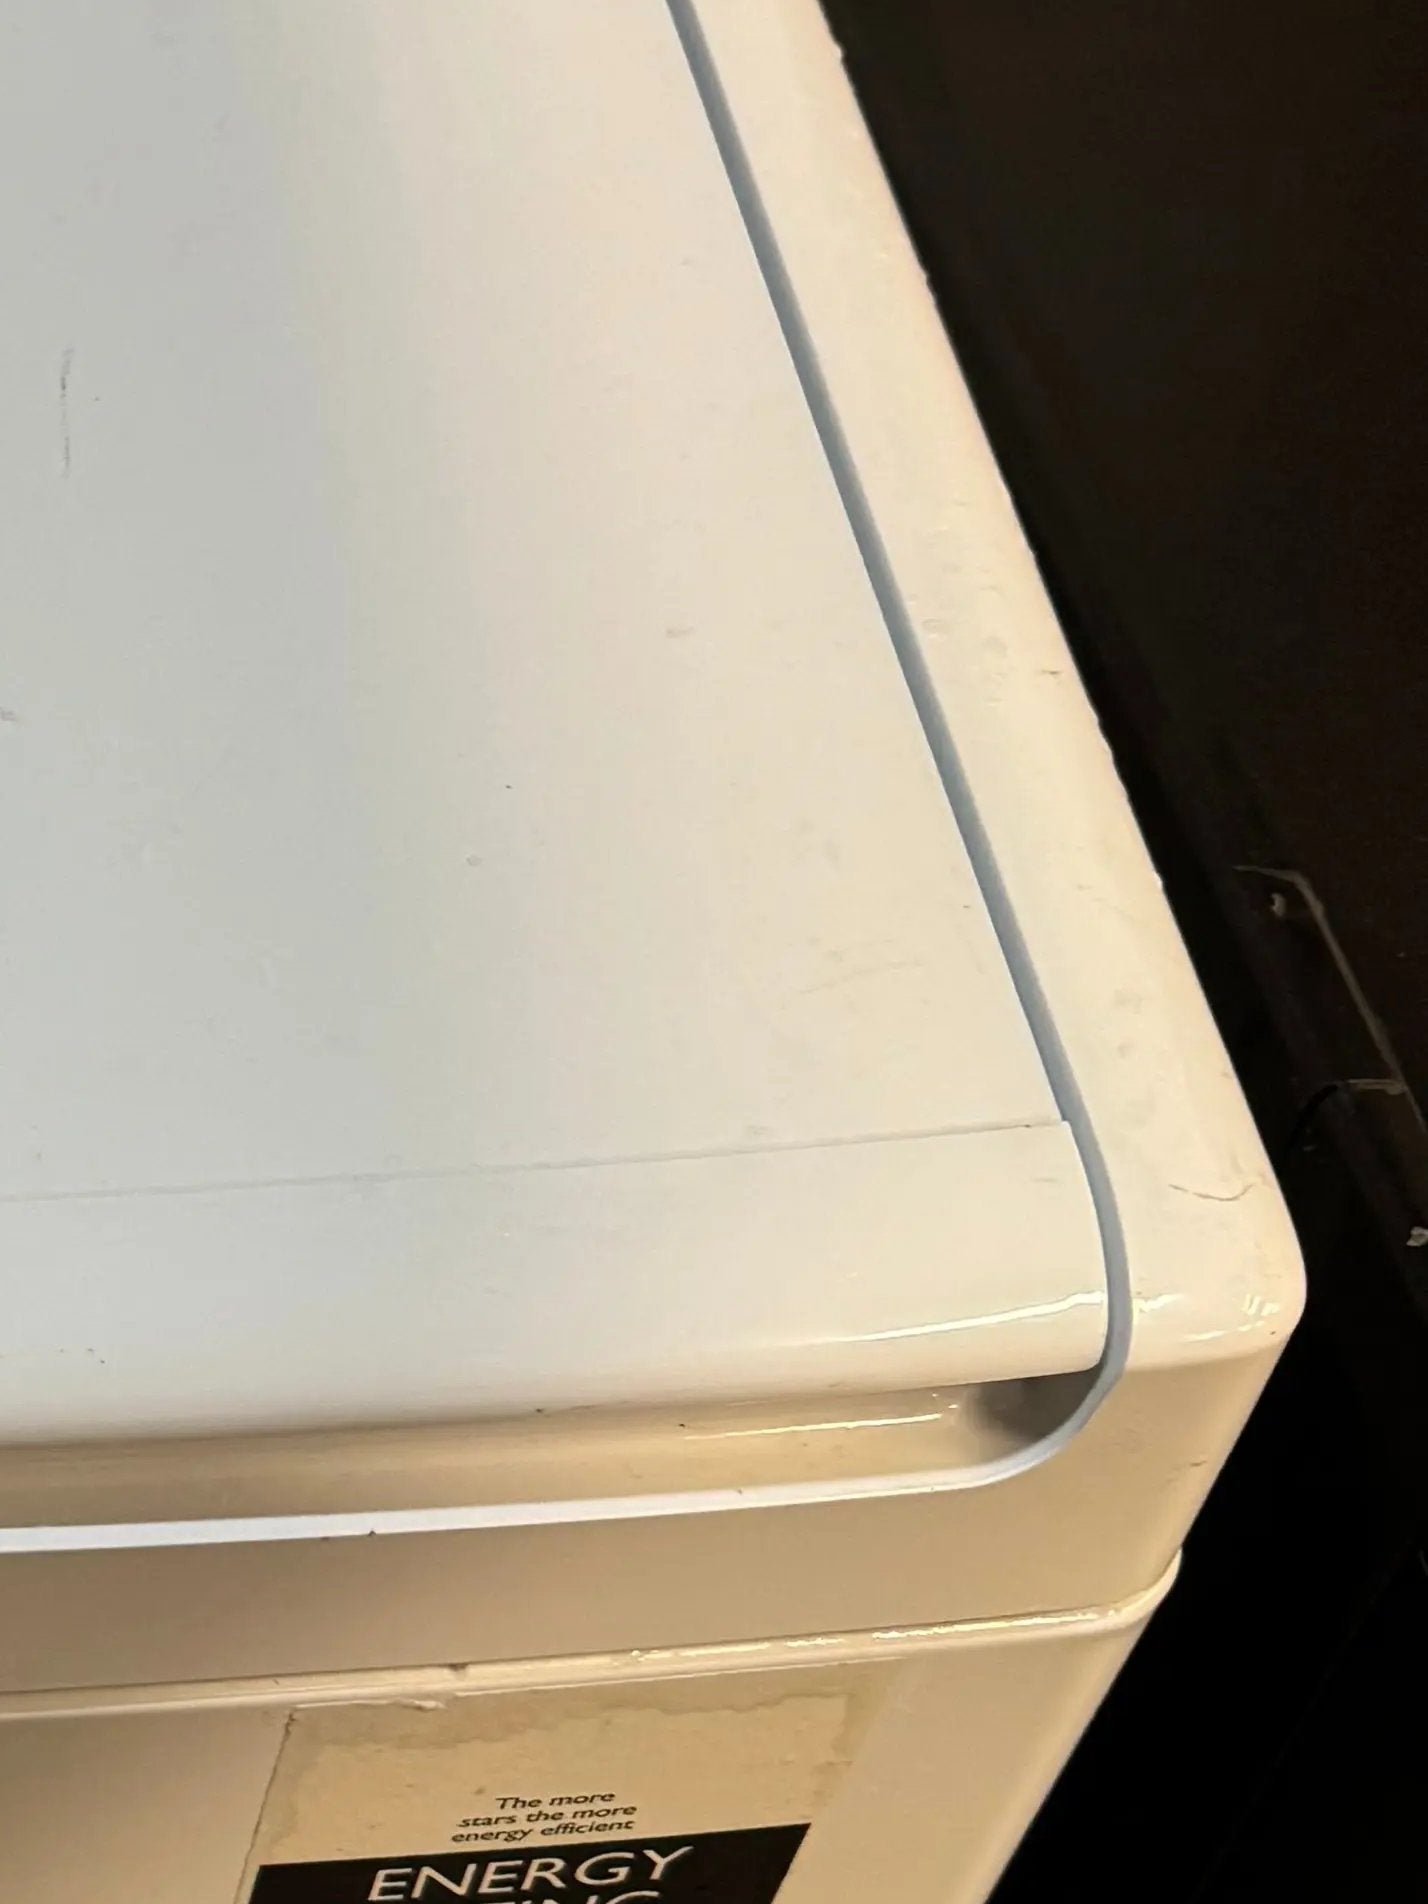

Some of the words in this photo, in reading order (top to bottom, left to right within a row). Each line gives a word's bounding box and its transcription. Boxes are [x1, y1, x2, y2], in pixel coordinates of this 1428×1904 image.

[496, 1797, 541, 1810] The
[549, 1793, 615, 1806] more
[456, 1813, 516, 1828] stars
[527, 1809, 563, 1823] the
[568, 1805, 637, 1819] more
[451, 1829, 532, 1844] energy
[540, 1820, 635, 1836] efficient
[368, 1846, 694, 1901] ENERGY
